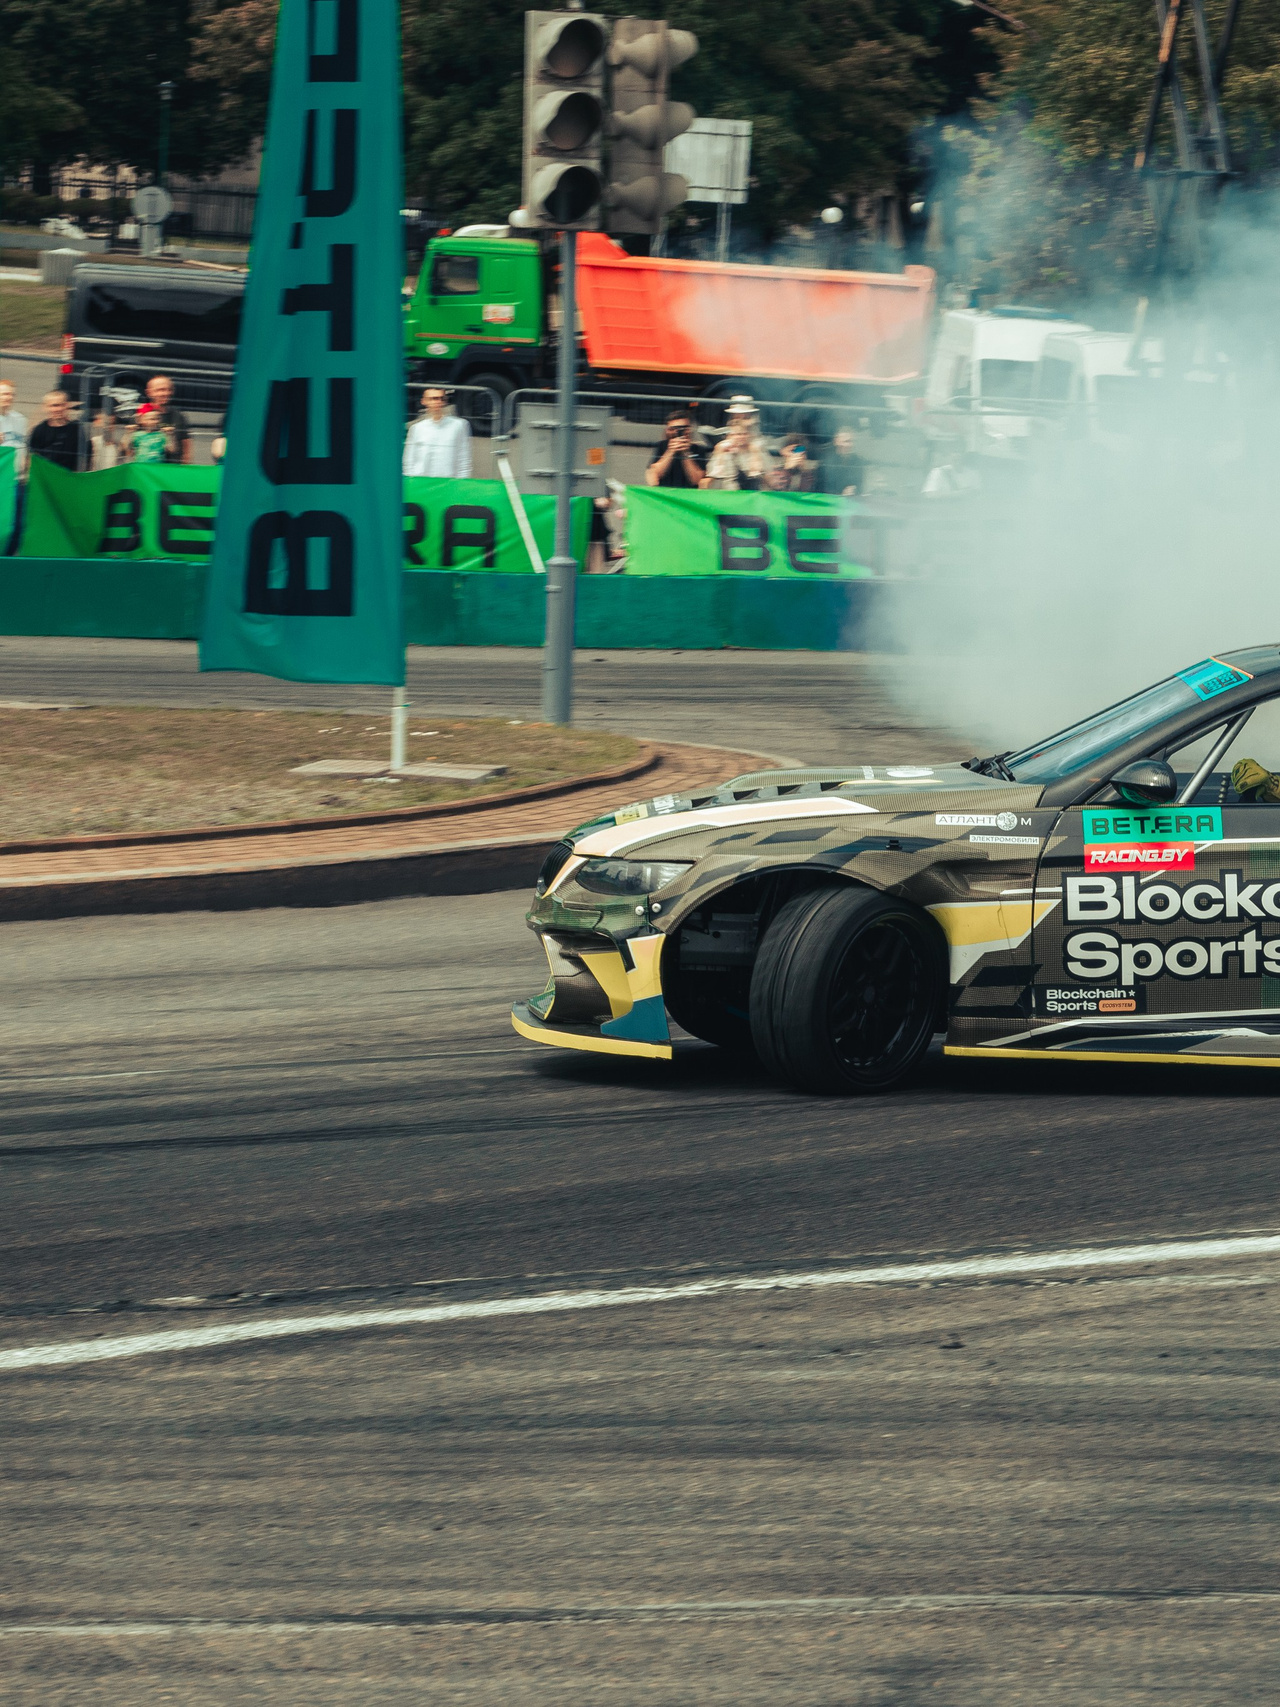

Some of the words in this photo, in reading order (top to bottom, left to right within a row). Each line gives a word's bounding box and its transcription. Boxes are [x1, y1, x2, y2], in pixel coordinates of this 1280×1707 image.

[939, 815, 995, 825] АТЛАНТ
[1091, 814, 1215, 836] BET.ERA
[970, 835, 1038, 844] ЭЛЕКТРОМОБИЛИ
[1090, 848, 1189, 864] RACING.BY
[1046, 988, 1127, 999] Blockchain
[1046, 1000, 1097, 1013] Sports
